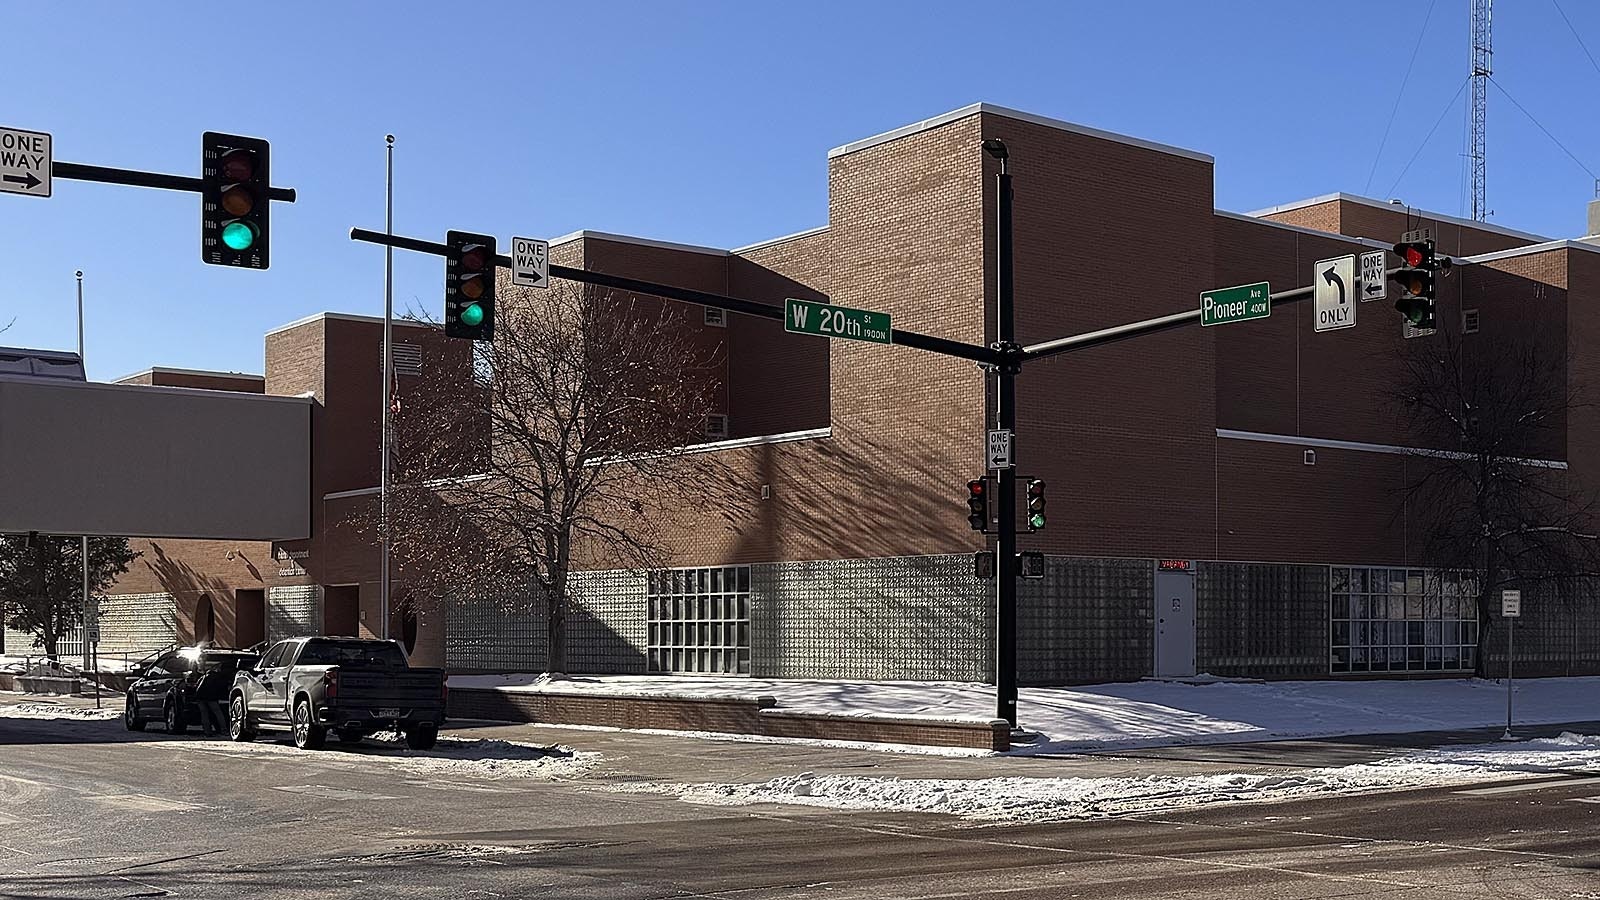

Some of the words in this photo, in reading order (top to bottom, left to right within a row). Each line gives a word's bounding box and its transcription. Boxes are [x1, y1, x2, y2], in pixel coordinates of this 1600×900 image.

[2, 133, 44, 153] ONE
[1, 151, 44, 170] WAY
[517, 241, 544, 256] ONE
[517, 255, 545, 269] WAY
[1363, 255, 1382, 268] ONE
[1363, 268, 1383, 281] WAY
[1250, 289, 1261, 298] Ave
[1203, 296, 1248, 321] Pioneer
[1250, 302, 1266, 313] 400W
[792, 304, 809, 328] W
[819, 308, 861, 336] 20th
[863, 315, 872, 324] St
[1320, 307, 1350, 324] ONLY
[864, 329, 886, 340] 1900N
[991, 433, 1008, 443] ONE
[991, 443, 1008, 454] WAY
